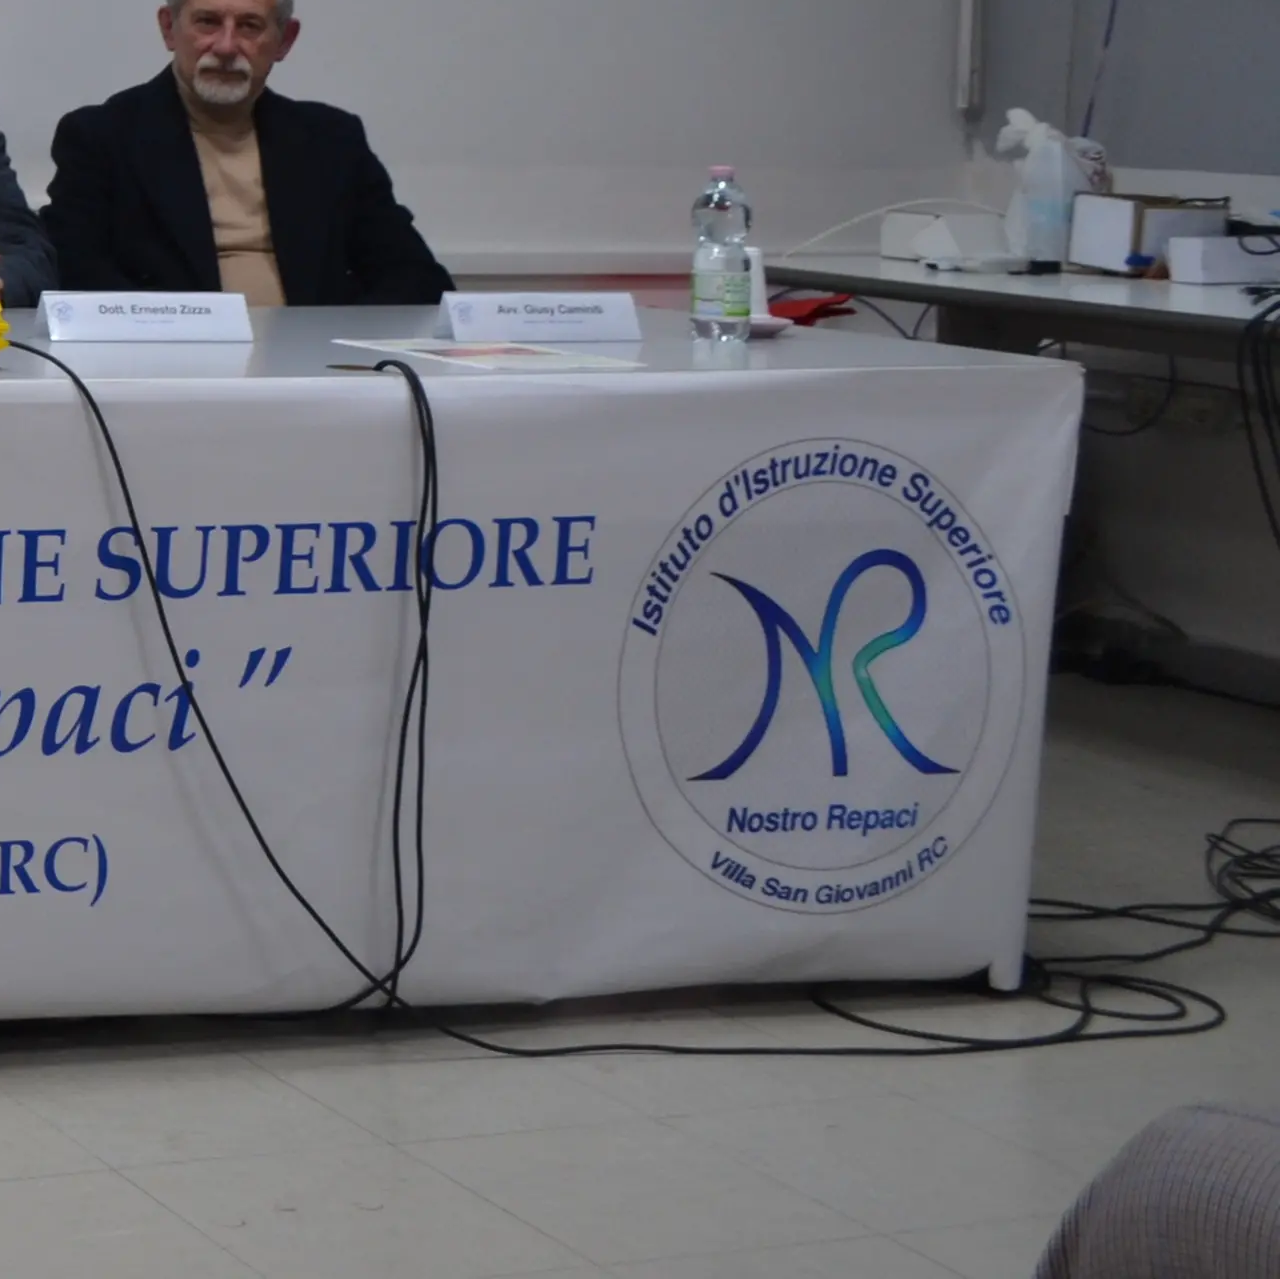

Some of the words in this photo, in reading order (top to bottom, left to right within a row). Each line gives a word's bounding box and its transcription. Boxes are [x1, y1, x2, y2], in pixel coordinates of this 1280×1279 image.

[131, 304, 178, 315] Ernesto
[180, 304, 212, 315] Zizza
[95, 515, 596, 601] SUPERIORE
[632, 511, 716, 638] Istituto
[718, 444, 900, 519] d'Istruzione
[902, 471, 1014, 627] Superiore
[726, 805, 818, 834] Nostro
[826, 802, 920, 838] Repaci
[710, 850, 757, 890] Villa
[761, 876, 809, 904] San
[814, 864, 915, 906] Giovanni
[916, 835, 951, 874] RC
